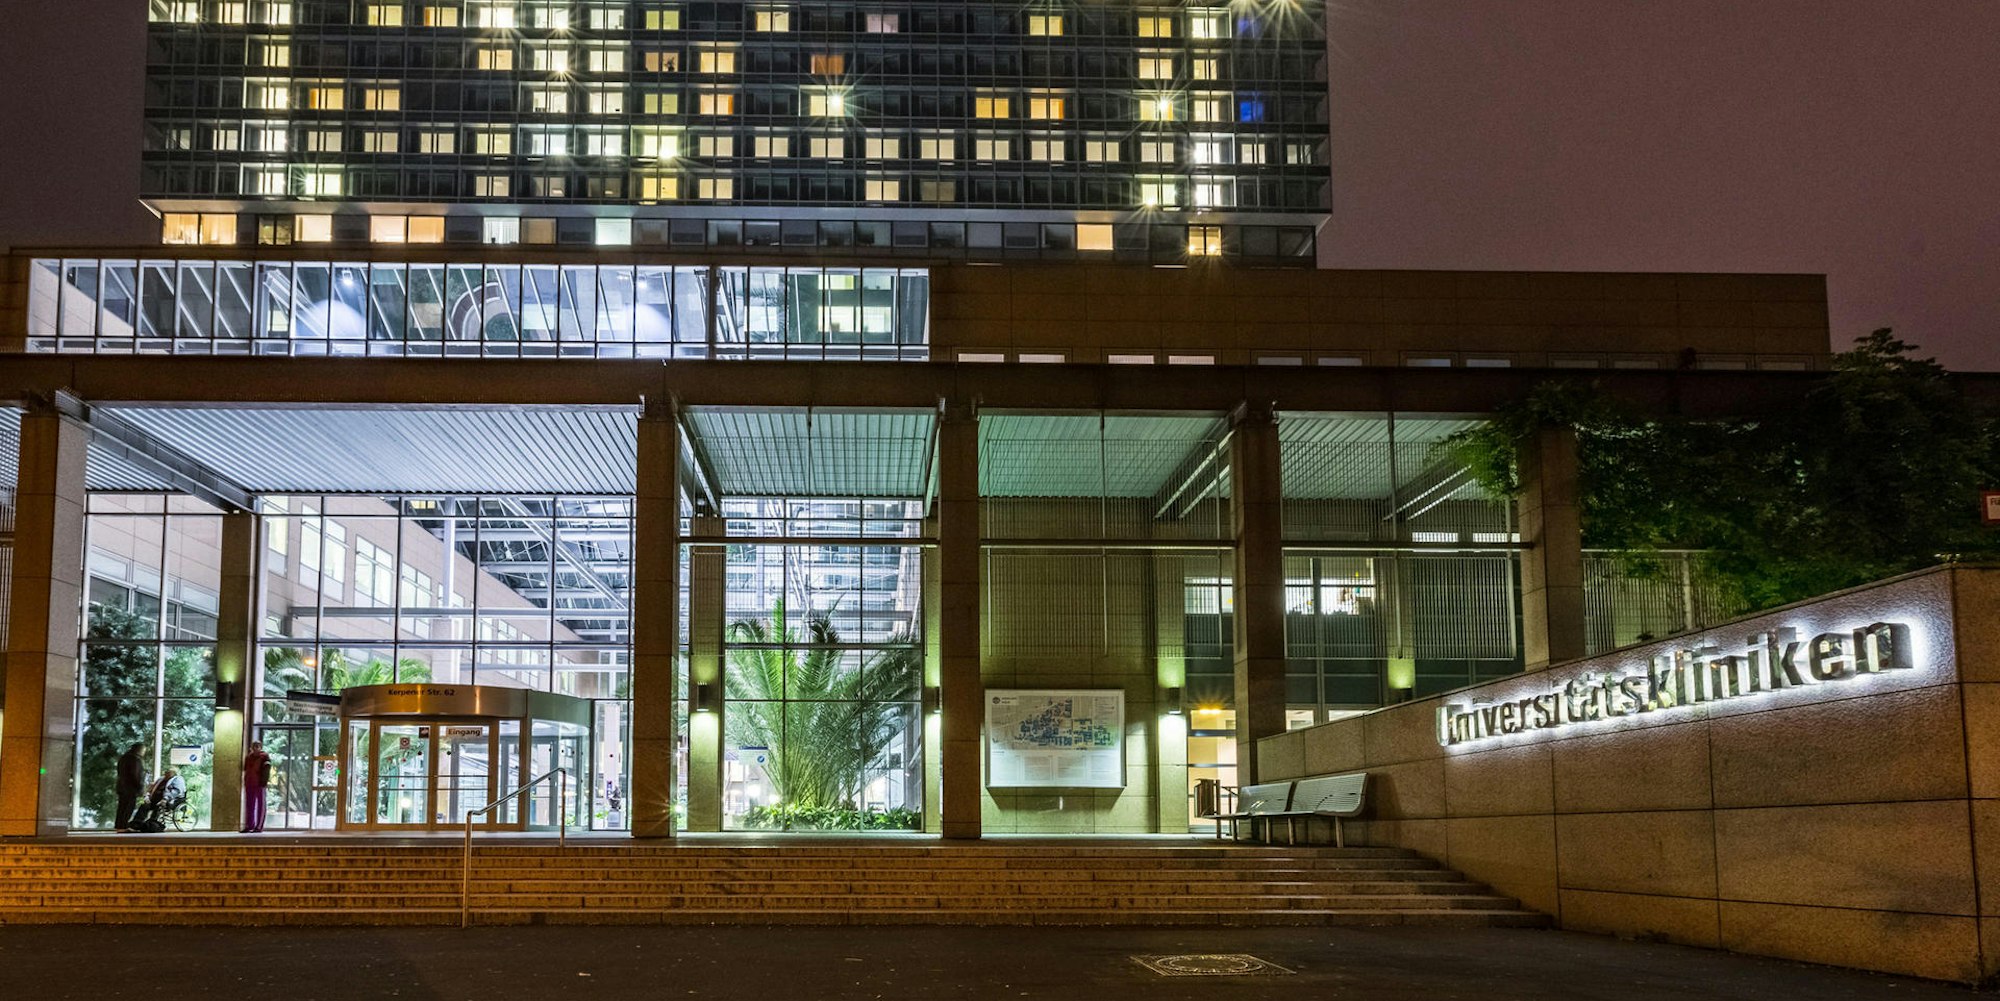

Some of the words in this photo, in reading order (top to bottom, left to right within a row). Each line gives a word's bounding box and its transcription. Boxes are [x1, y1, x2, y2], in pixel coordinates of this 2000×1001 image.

[1436, 621, 1913, 747] Universitätskliniken
[444, 688, 455, 696] 62
[448, 728, 481, 736] Eingang
